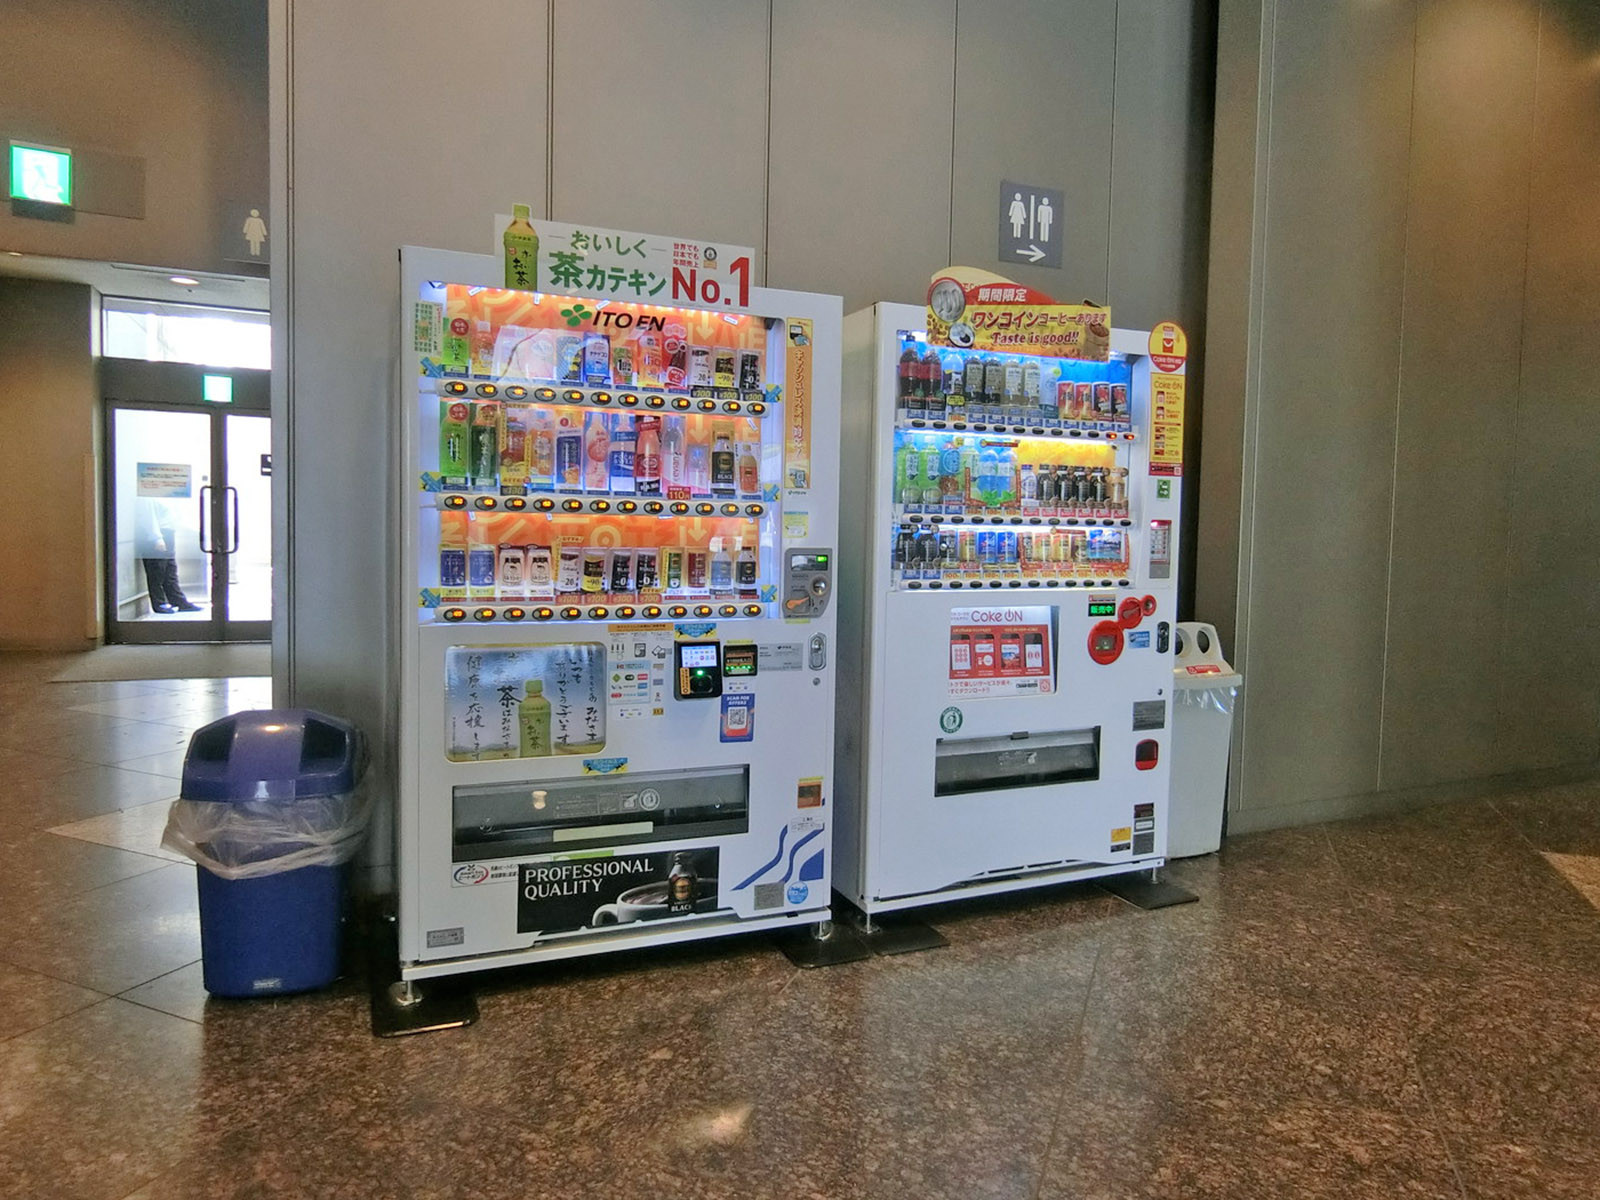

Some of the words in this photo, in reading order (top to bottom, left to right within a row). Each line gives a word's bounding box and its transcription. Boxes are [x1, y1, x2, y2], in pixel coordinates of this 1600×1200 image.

[571, 230, 647, 258] おいしく
[673, 243, 699, 252] 世界でも
[673, 251, 699, 260] 日本でも
[548, 251, 667, 297] 茶カテキン
[672, 257, 750, 308] No.1
[977, 288, 1027, 303] 期間限定
[593, 310, 633, 329] ITO
[636, 315, 666, 332] EN
[972, 311, 1107, 329] ワンコインコーヒーあります
[992, 331, 1026, 345] Taste
[1029, 332, 1041, 344] is
[1042, 331, 1080, 346] good!!
[971, 610, 1003, 622] Coke
[1004, 609, 1023, 622] ON
[1090, 605, 1114, 614] 販売中
[948, 680, 1011, 688] トクで楽しいサービスが続々
[497, 651, 523, 758] 茶はみなさまの
[525, 858, 654, 883] PROFESSIONAL
[524, 879, 603, 901] QUALITY
